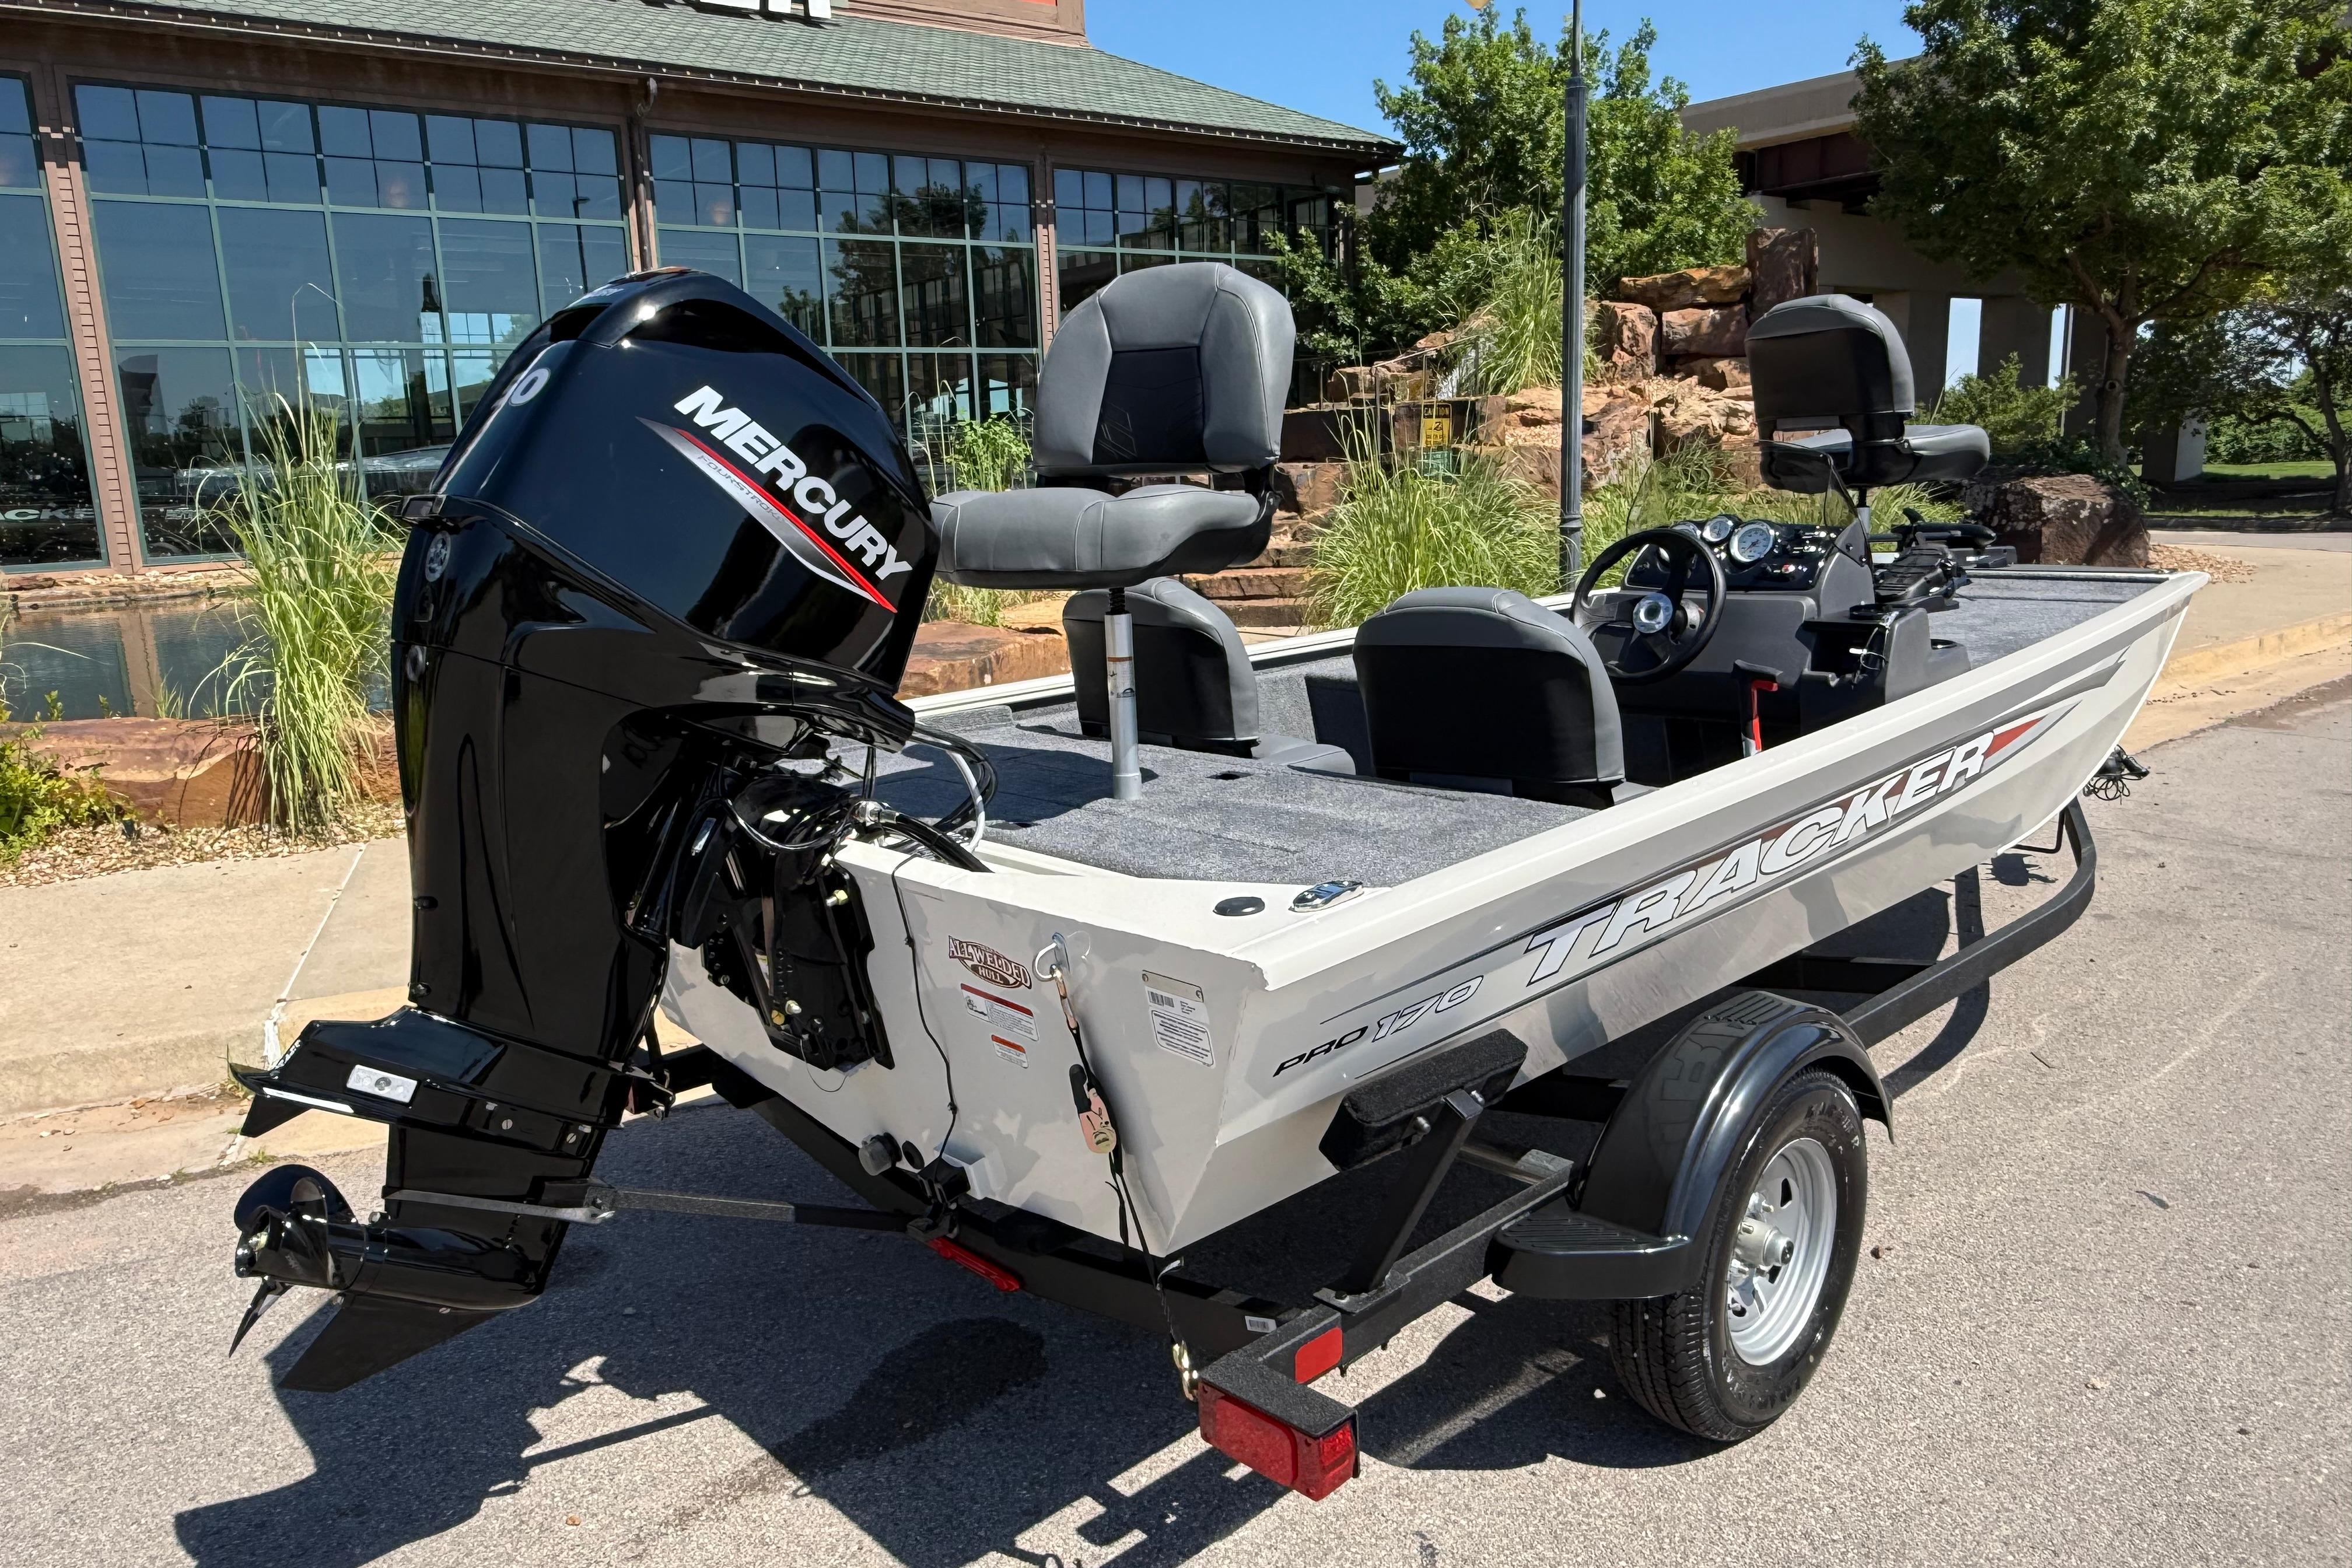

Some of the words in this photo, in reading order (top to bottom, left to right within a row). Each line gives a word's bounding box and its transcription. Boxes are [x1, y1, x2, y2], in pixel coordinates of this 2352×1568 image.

[674, 384, 913, 580] MERCURY
[1524, 729, 1996, 987] TRACKER
[949, 937, 974, 960] ALL
[968, 944, 1031, 987] WELDED
[978, 965, 1004, 984] HULL
[1272, 1025, 1368, 1078] PRO
[1371, 974, 1485, 1043] 170
